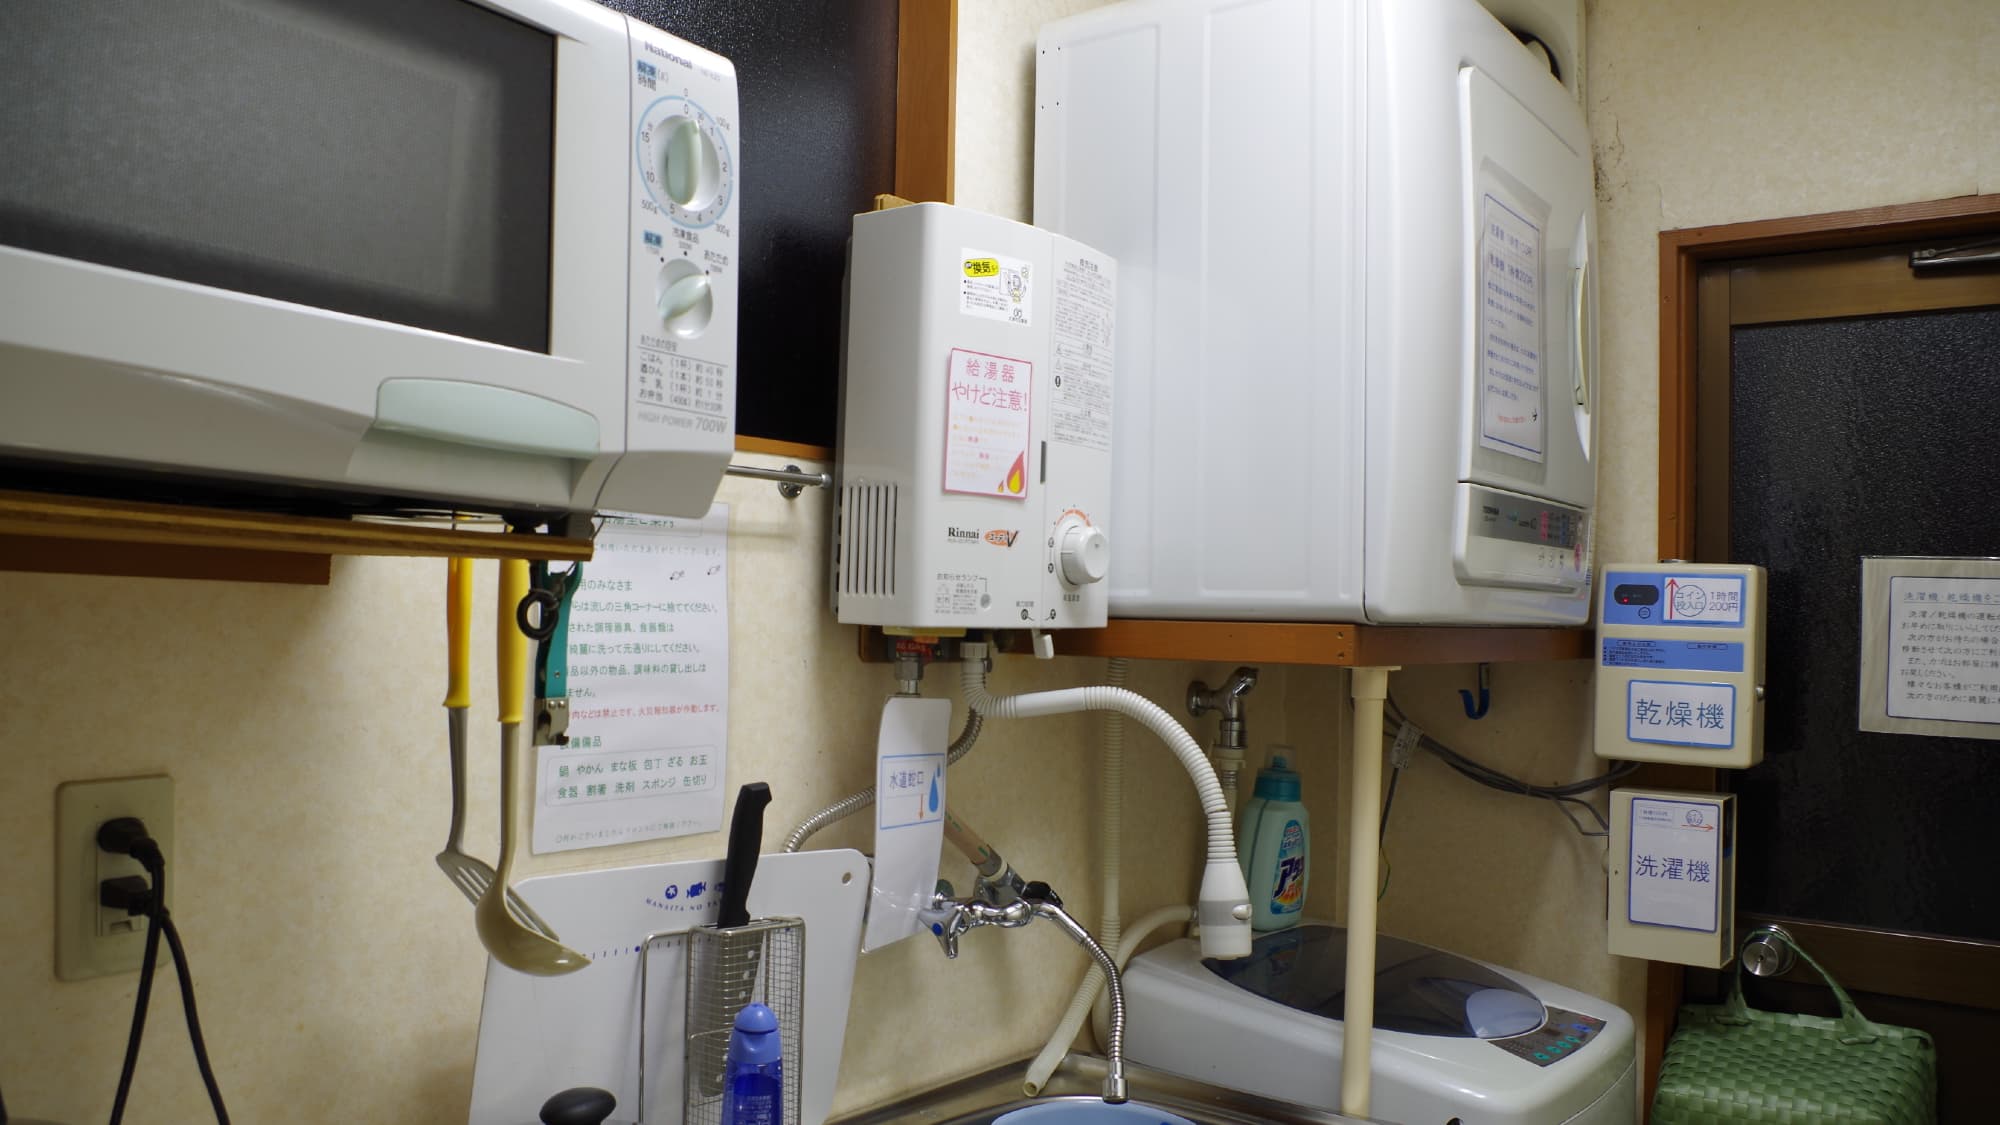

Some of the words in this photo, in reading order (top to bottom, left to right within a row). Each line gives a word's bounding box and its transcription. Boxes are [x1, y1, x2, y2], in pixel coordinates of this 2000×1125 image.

[644, 40, 693, 70] National
[641, 131, 650, 143] 15
[646, 170, 655, 183] 10
[965, 357, 1016, 384] 給湯器
[695, 415, 728, 434] 700W
[947, 527, 980, 539] Rinnai
[1677, 591, 1705, 601] コイン
[1710, 591, 1739, 602] 1時間
[1677, 600, 1705, 610] 投入口
[1708, 602, 1739, 612] 200円
[567, 663, 707, 677] 品以外の物品、調味料の貸し出しは
[1635, 698, 1725, 730] 乾燥機
[611, 760, 638, 773] まな板
[1635, 855, 1712, 884] 洗濯機
